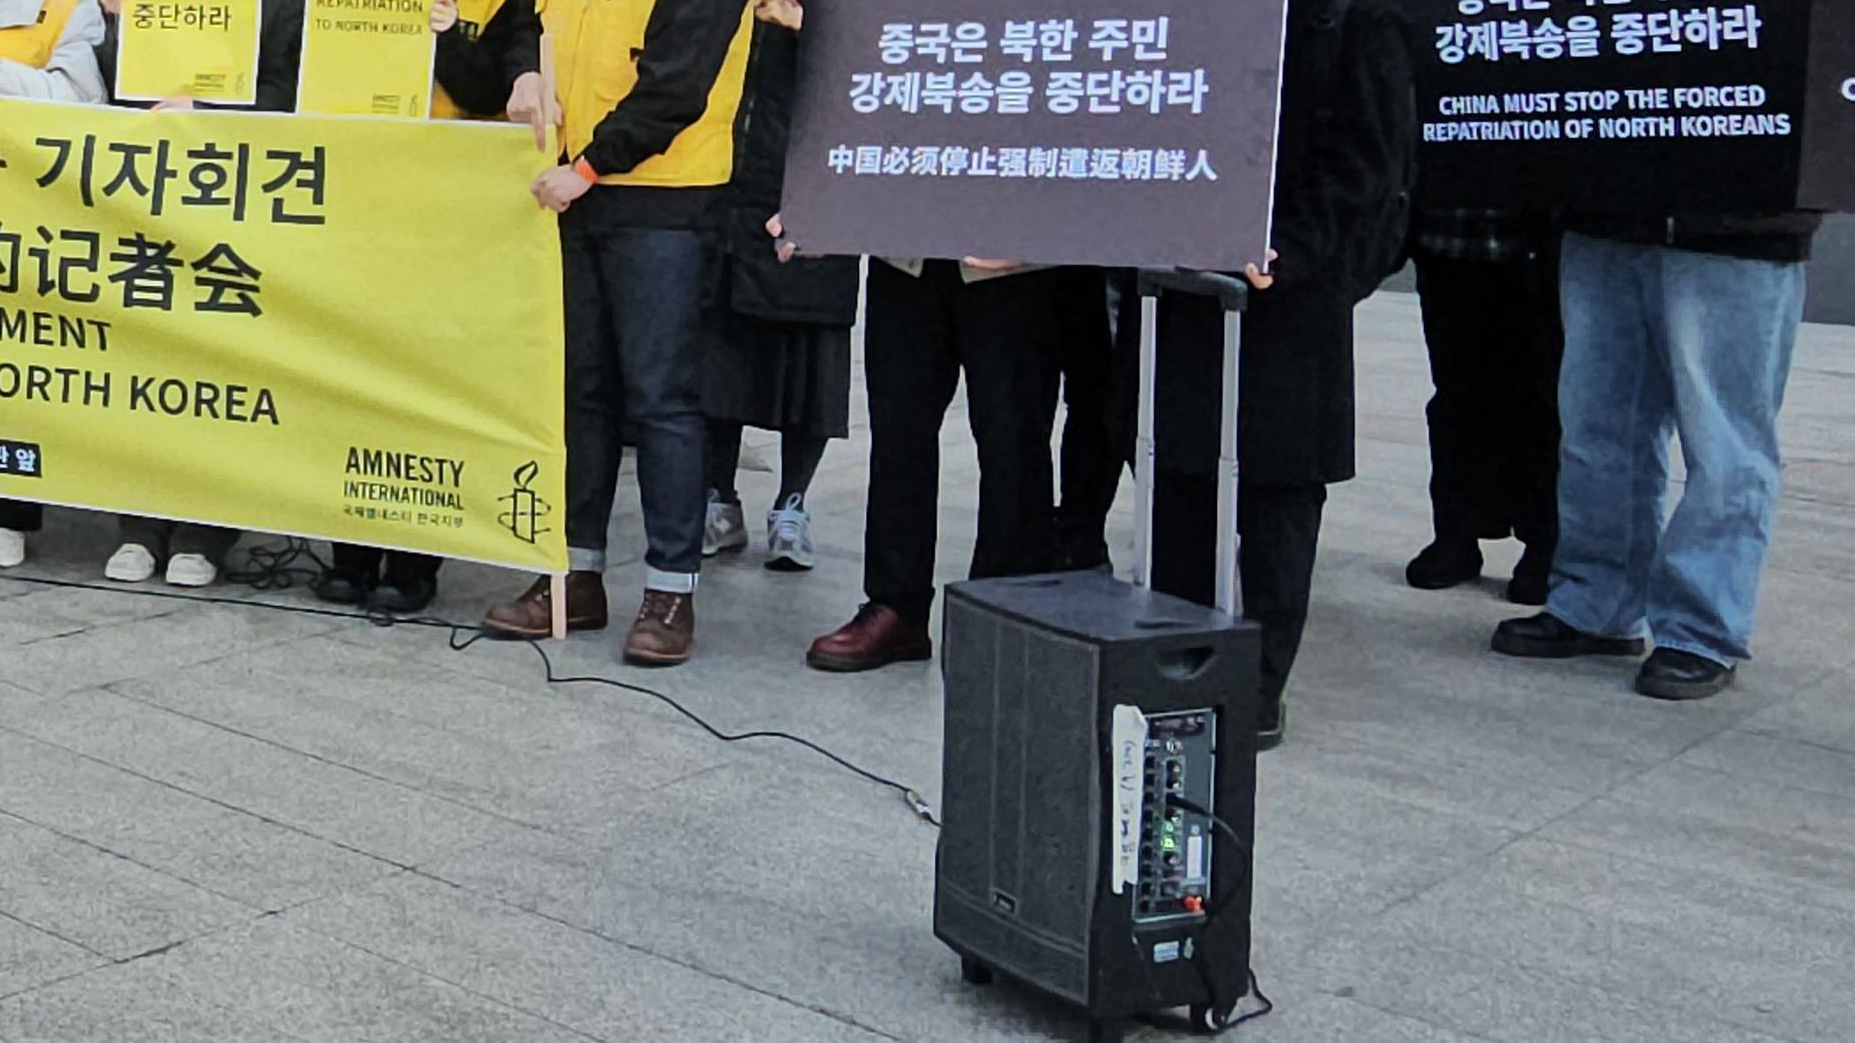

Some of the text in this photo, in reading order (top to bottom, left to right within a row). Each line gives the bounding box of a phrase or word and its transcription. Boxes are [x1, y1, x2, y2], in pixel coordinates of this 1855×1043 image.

[132, 2, 233, 33] 중단하라
[315, 18, 423, 37] TO NORTH KOREA
[1435, 4, 1762, 64] 강제북송을 중단하라
[878, 16, 1170, 64] 중국은 북한 주민
[849, 68, 1209, 115] 강제북송을 중단하라
[1439, 84, 1767, 116] CHINA MUST STOP THE FORCED
[1423, 113, 1792, 142] REPATRIATION OF NORTH KOREANS
[34, 133, 327, 226] 기자회견
[128, 374, 281, 426] KOREA
[14, 449, 38, 473] 앞
[344, 445, 466, 489] AMNESTY
[343, 479, 466, 512] INTERNATIONAL
